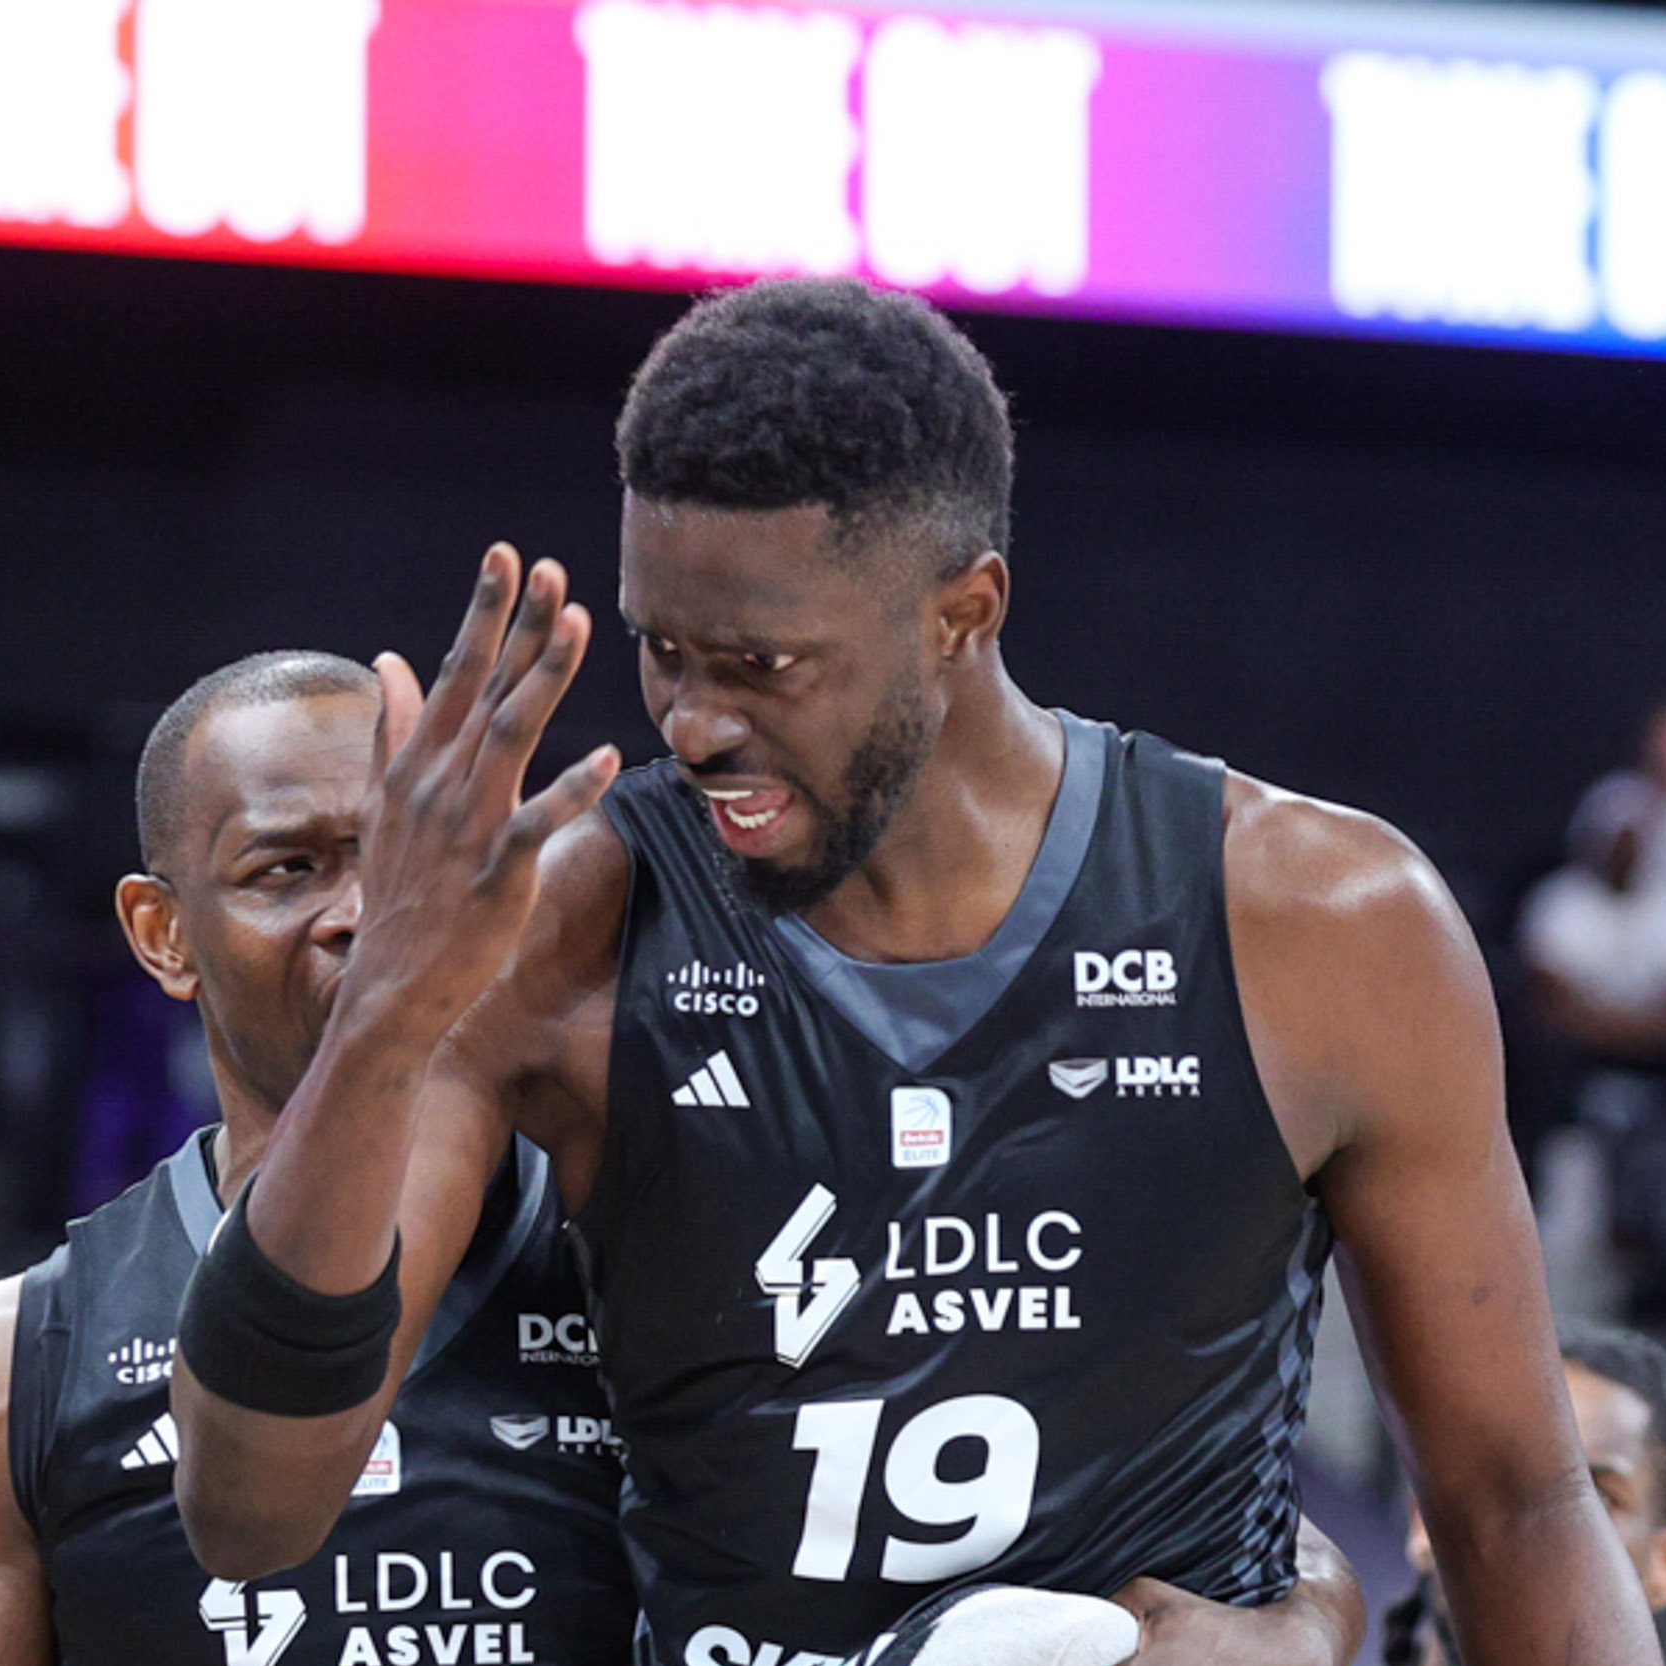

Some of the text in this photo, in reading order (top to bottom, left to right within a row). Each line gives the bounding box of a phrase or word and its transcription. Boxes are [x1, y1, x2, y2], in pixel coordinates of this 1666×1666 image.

[1074, 950, 1177, 992] DCB
[674, 991, 758, 1016] CISCO
[1116, 1057, 1199, 1086] LDLC
[885, 1211, 1081, 1279] LDLC
[887, 1287, 1080, 1334] ASVEL
[557, 1416, 623, 1444] LDL
[793, 1395, 1039, 1581] 19
[336, 1552, 535, 1612] LDLC
